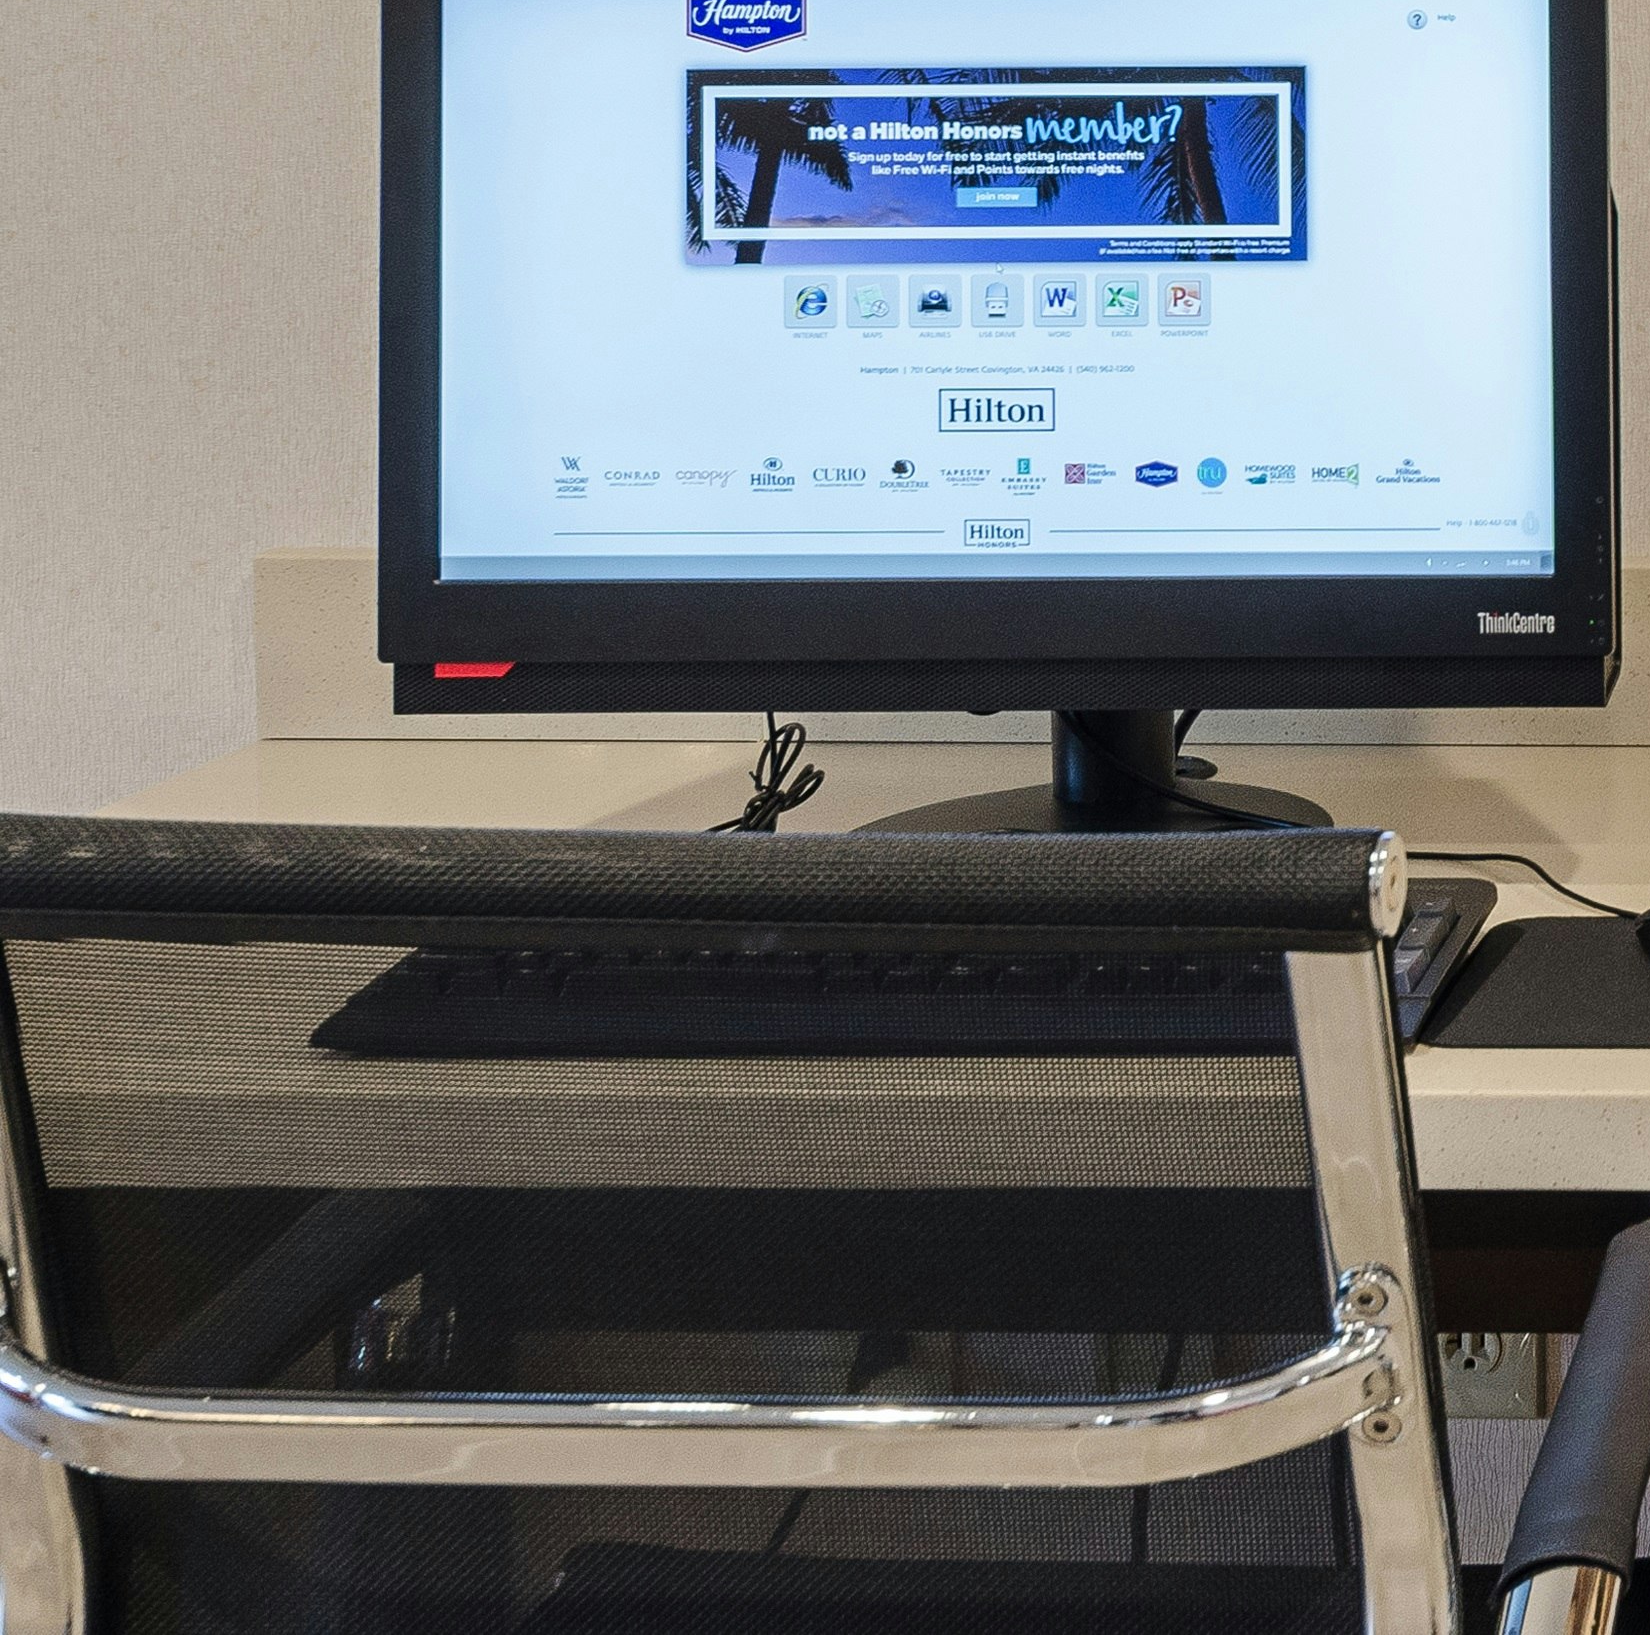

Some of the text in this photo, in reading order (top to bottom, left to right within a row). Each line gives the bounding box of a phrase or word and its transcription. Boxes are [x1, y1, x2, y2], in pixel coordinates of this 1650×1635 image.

[722, 26, 771, 36] by HILTON
[808, 101, 1183, 145] not a Hilton Honors member?
[848, 150, 1145, 164] Sign up today for free to start getting instant benefits
[871, 164, 1125, 176] like Free Wi-Fi and Points towards free nights.
[975, 191, 1020, 203] join now
[860, 366, 900, 375] Hampton
[955, 366, 980, 374] Street
[948, 398, 1046, 423] Hilton
[604, 470, 661, 481] CONRAD
[674, 469, 739, 488] canopy
[750, 473, 796, 487] Hilton
[812, 468, 866, 482] CURIO
[940, 469, 992, 477] TAPESTRY
[969, 524, 1025, 539] Hilton
[1477, 612, 1556, 634] ThinkCentre
